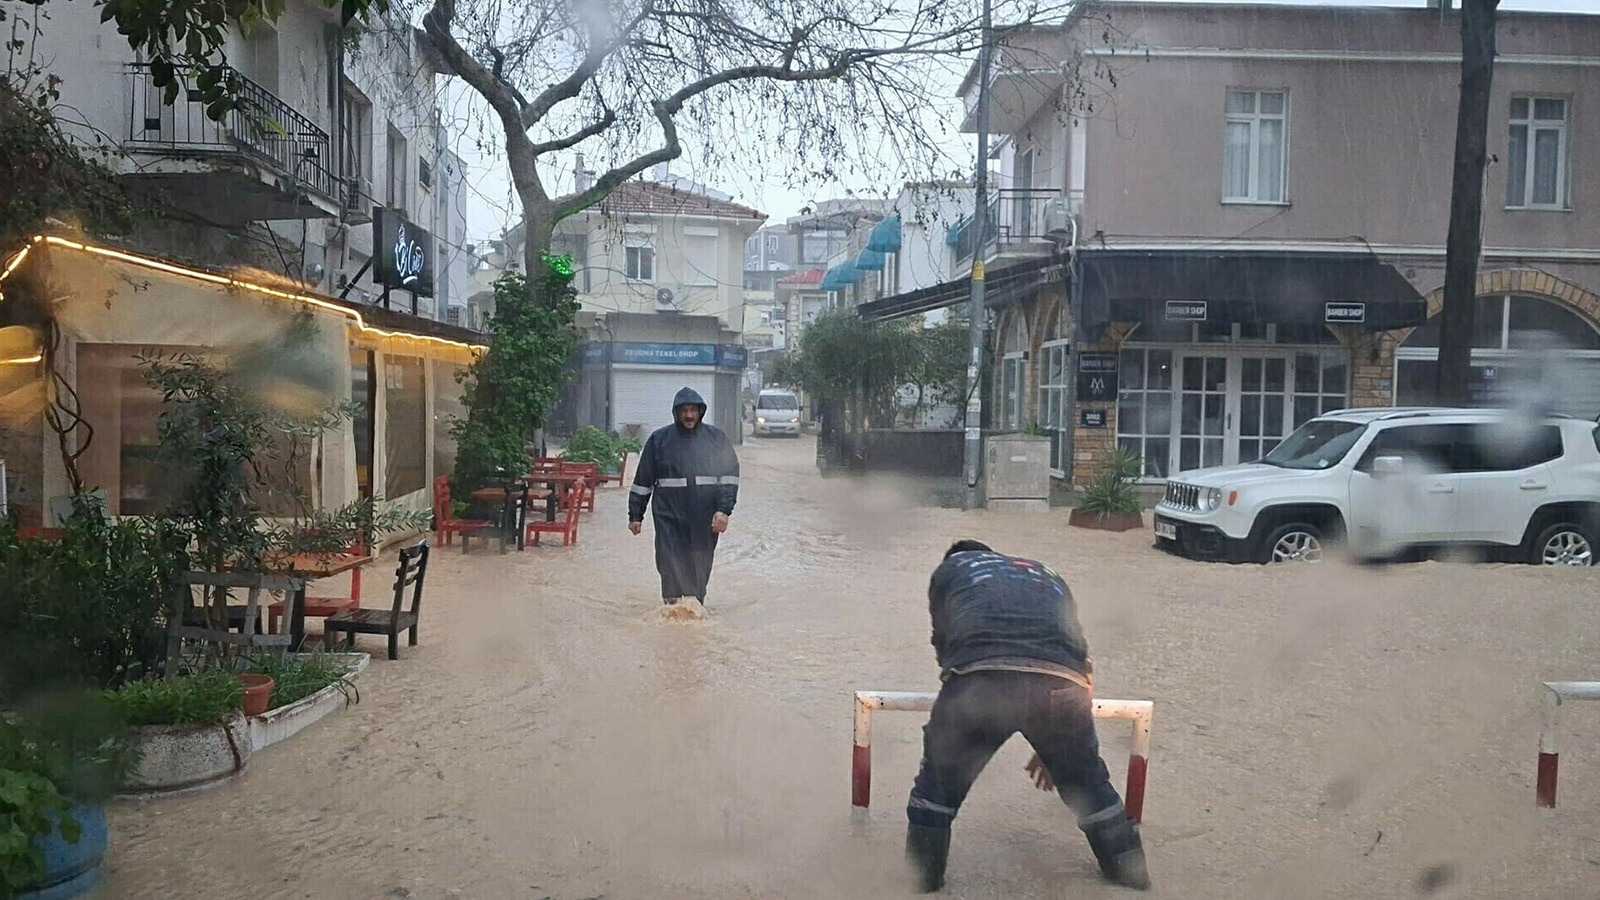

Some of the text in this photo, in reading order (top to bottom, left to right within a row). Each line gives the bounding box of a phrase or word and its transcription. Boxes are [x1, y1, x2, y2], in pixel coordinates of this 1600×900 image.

[1327, 308, 1363, 317] BARBER SHOP
[679, 350, 699, 359] SHOP
